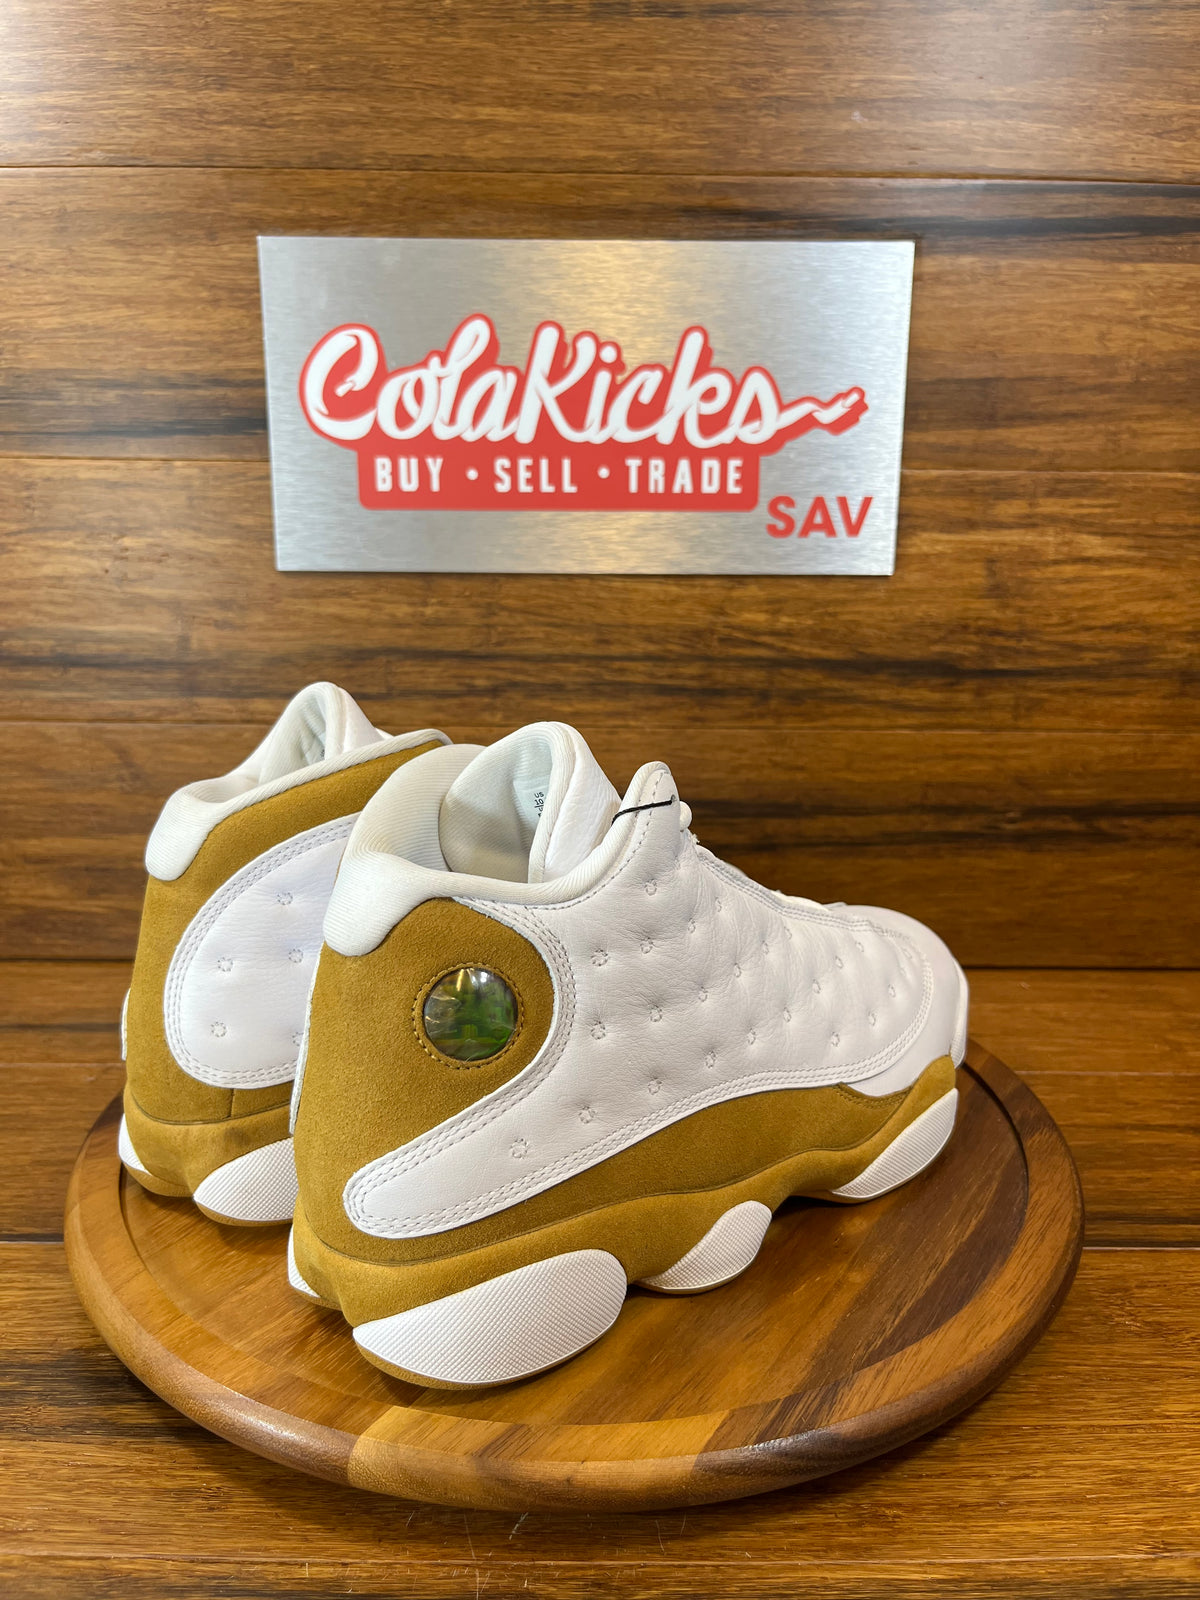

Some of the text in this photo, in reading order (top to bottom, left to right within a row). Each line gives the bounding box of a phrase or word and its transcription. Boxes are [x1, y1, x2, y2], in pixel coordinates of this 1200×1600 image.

[304, 318, 862, 449] ColaKicks
[374, 456, 744, 495] BUY SELL TRADE
[765, 495, 874, 539] SAV
